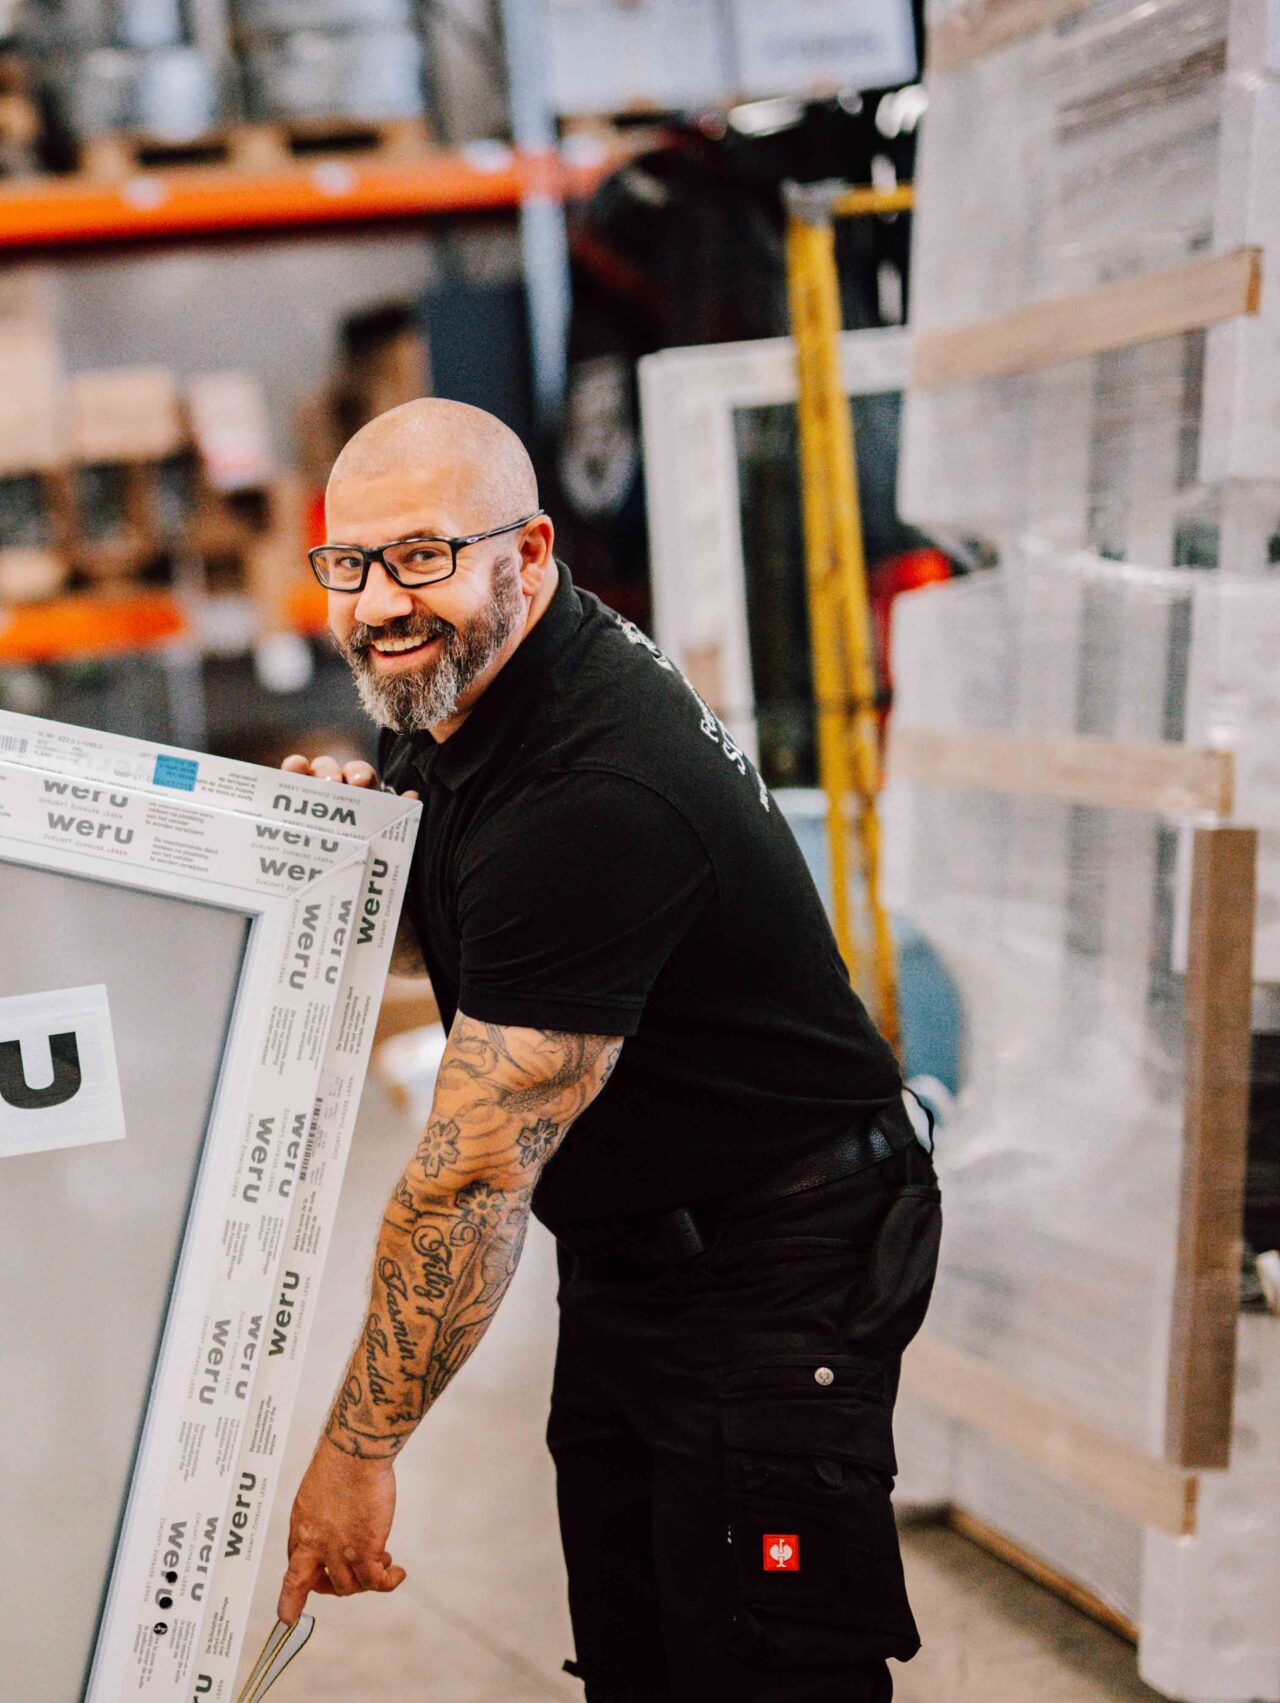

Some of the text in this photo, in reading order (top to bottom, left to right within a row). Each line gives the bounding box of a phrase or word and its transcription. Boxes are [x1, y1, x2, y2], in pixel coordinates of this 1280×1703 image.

[47, 812, 133, 844] weru
[272, 794, 356, 825] weru
[260, 857, 322, 881] wer
[356, 858, 388, 944] weru
[289, 903, 321, 989] weru
[242, 1117, 274, 1203] weru
[268, 1270, 299, 1355] weru
[198, 1319, 230, 1404] weru
[224, 1471, 256, 1557] weru
